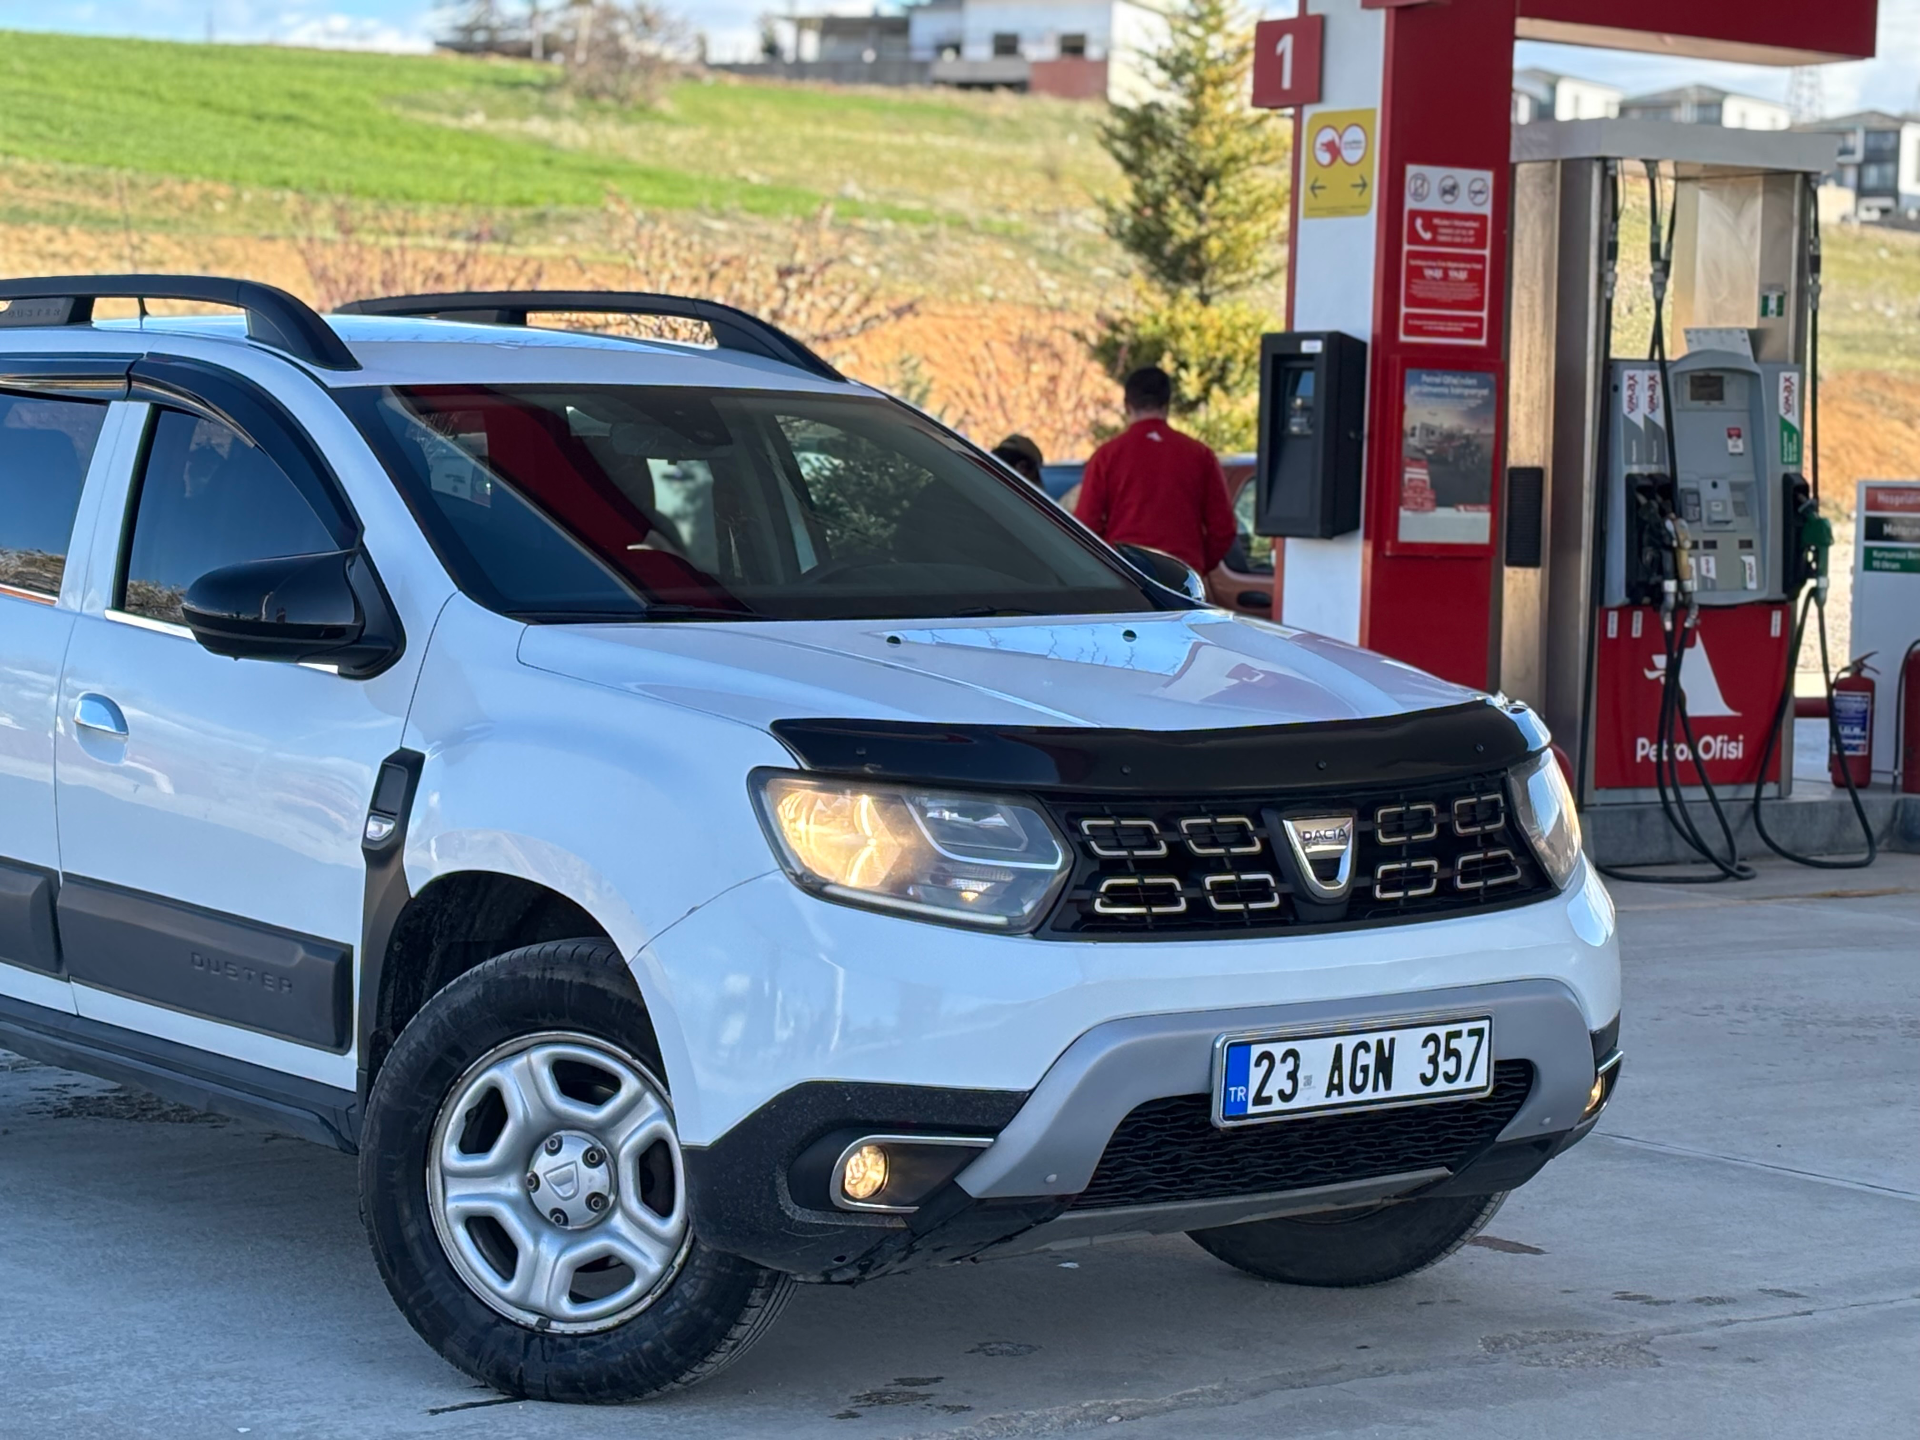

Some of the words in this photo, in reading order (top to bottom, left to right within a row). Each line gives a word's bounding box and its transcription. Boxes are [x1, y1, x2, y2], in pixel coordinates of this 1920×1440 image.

[1275, 33, 1294, 90] 1
[1697, 734, 1744, 761] Ofisi
[1302, 828, 1347, 842] DACIA
[191, 951, 293, 995] DUSTER
[1229, 1085, 1247, 1103] TR
[1252, 1048, 1300, 1107] 23
[1325, 1037, 1396, 1098] AGN
[1419, 1027, 1485, 1087] 357
